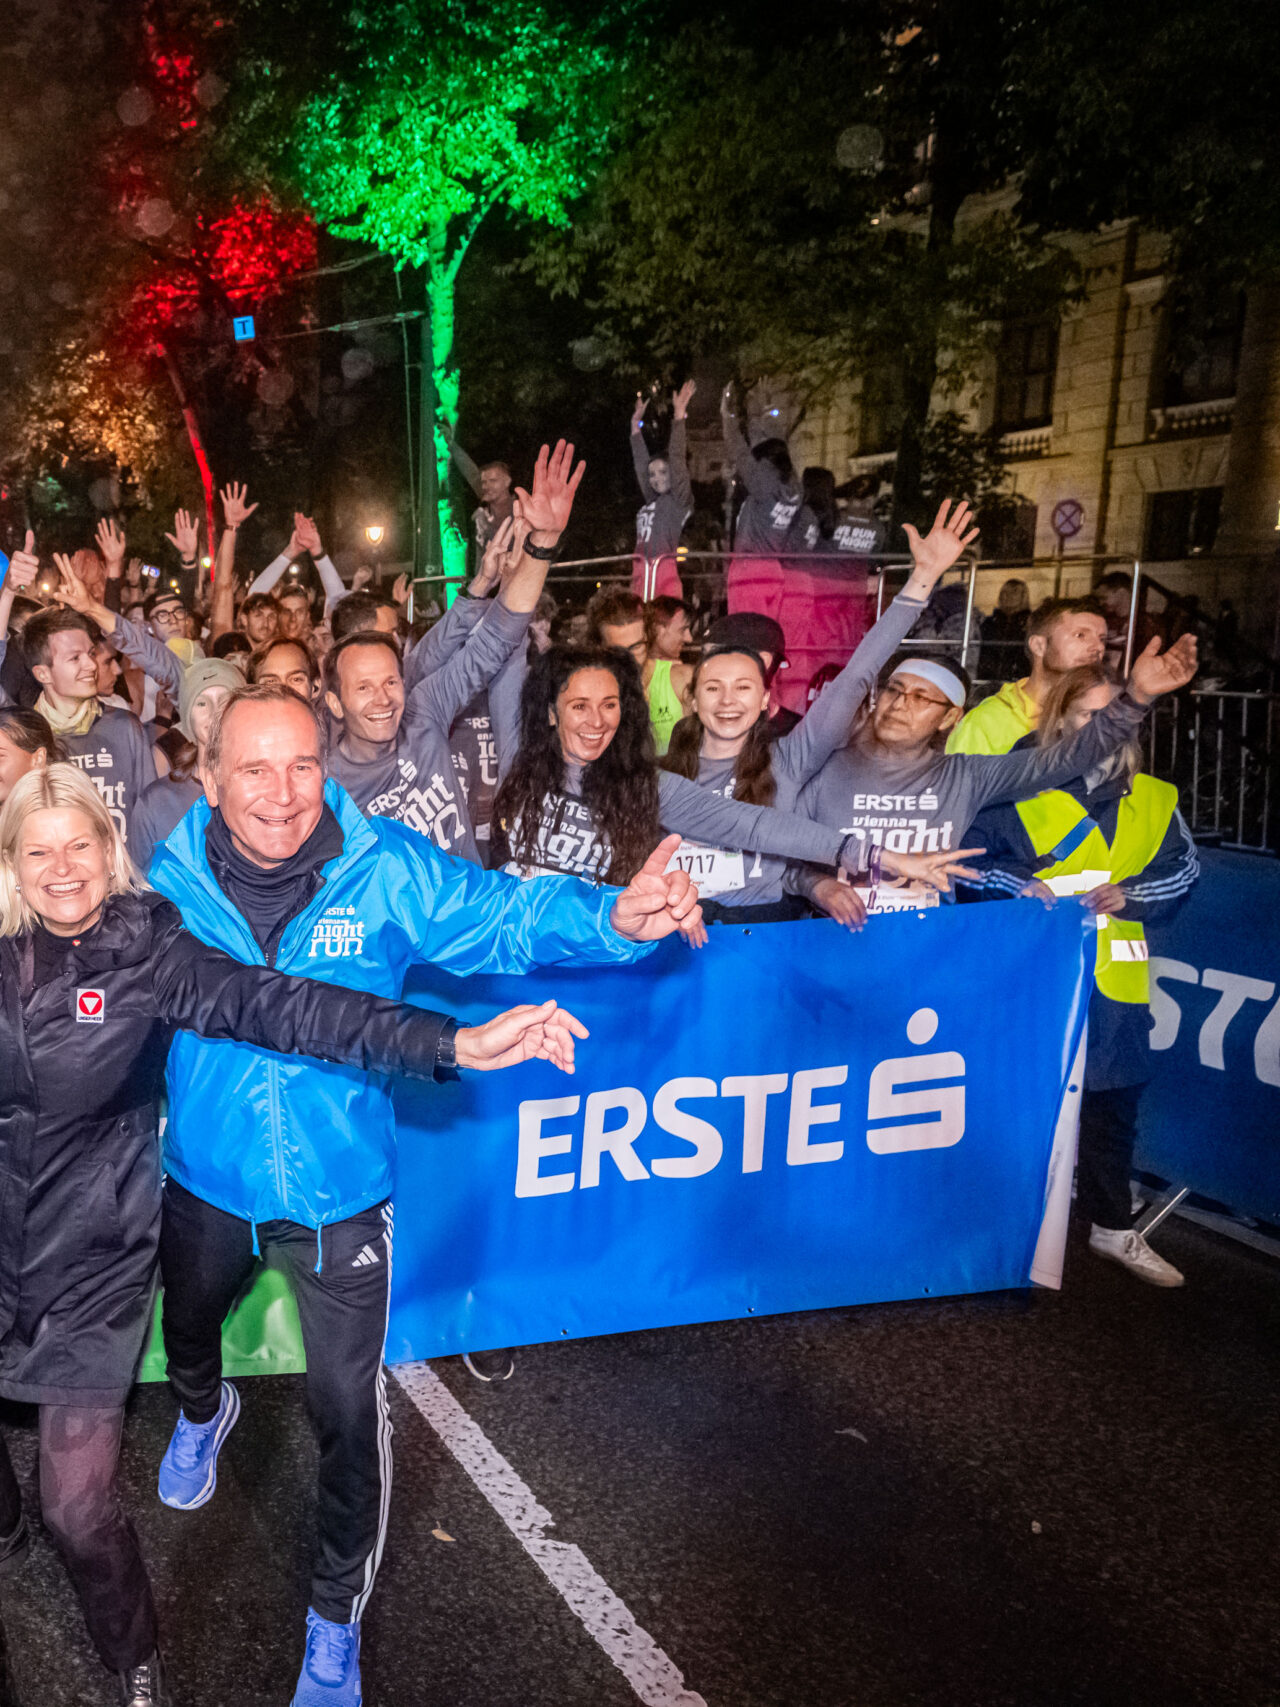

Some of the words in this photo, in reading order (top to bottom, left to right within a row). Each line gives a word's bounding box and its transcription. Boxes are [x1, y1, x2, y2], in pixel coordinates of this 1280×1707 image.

[236, 320, 249, 335] T
[853, 794, 917, 811] ERSTE
[852, 815, 908, 828] vienna
[676, 854, 715, 875] 1717
[312, 919, 365, 942] night
[308, 937, 363, 958] run
[514, 1064, 849, 1199] ERSTE
